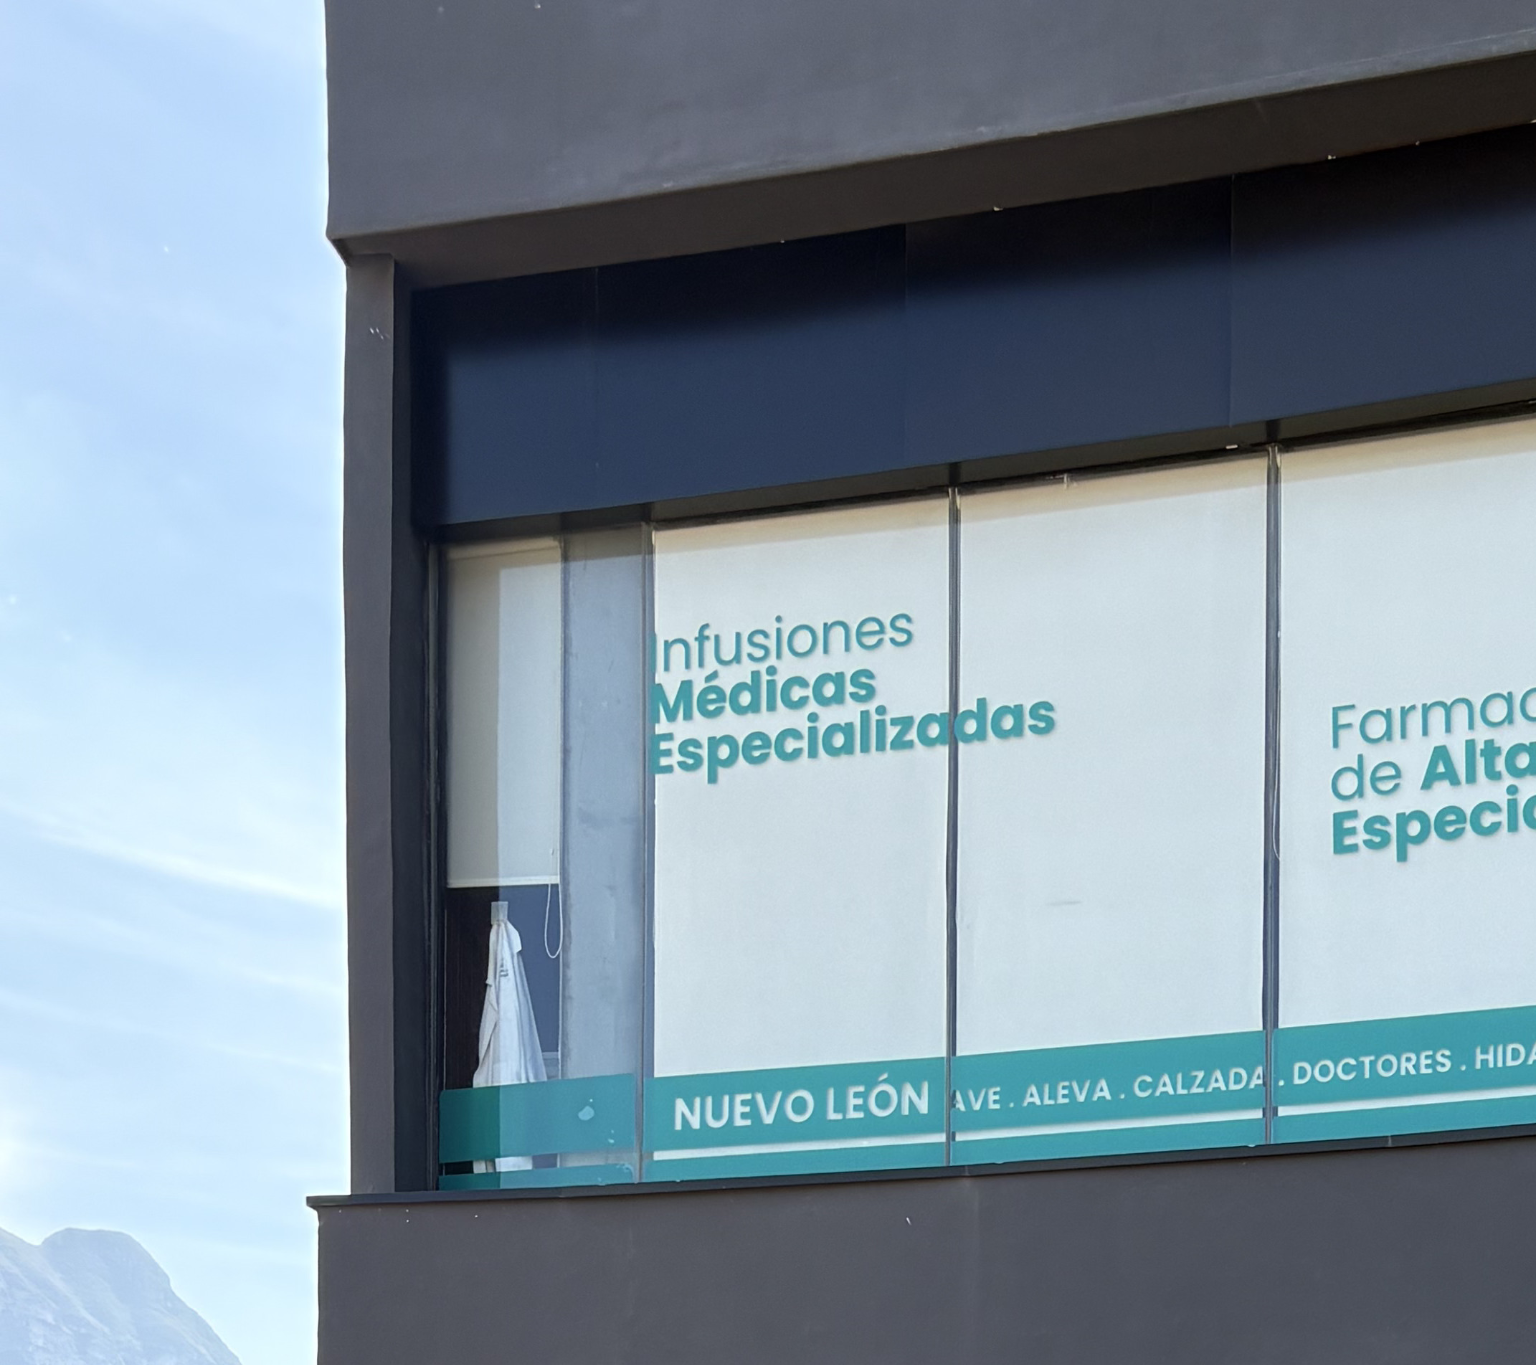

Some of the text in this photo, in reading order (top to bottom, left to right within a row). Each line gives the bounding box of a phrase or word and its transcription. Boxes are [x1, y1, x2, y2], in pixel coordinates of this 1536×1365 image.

[650, 611, 914, 673] Infusiones
[651, 664, 877, 724] Médicas
[651, 697, 1056, 784] Especializadas
[1330, 754, 1402, 801] de
[674, 1089, 814, 1131] NUEVO
[826, 1073, 930, 1122] LEÓN
[953, 1087, 1001, 1113] AVE
[1022, 1079, 1112, 1108] ALEVA
[1133, 1066, 1264, 1098] CALZADA
[1292, 1049, 1452, 1085] DOCTORES
